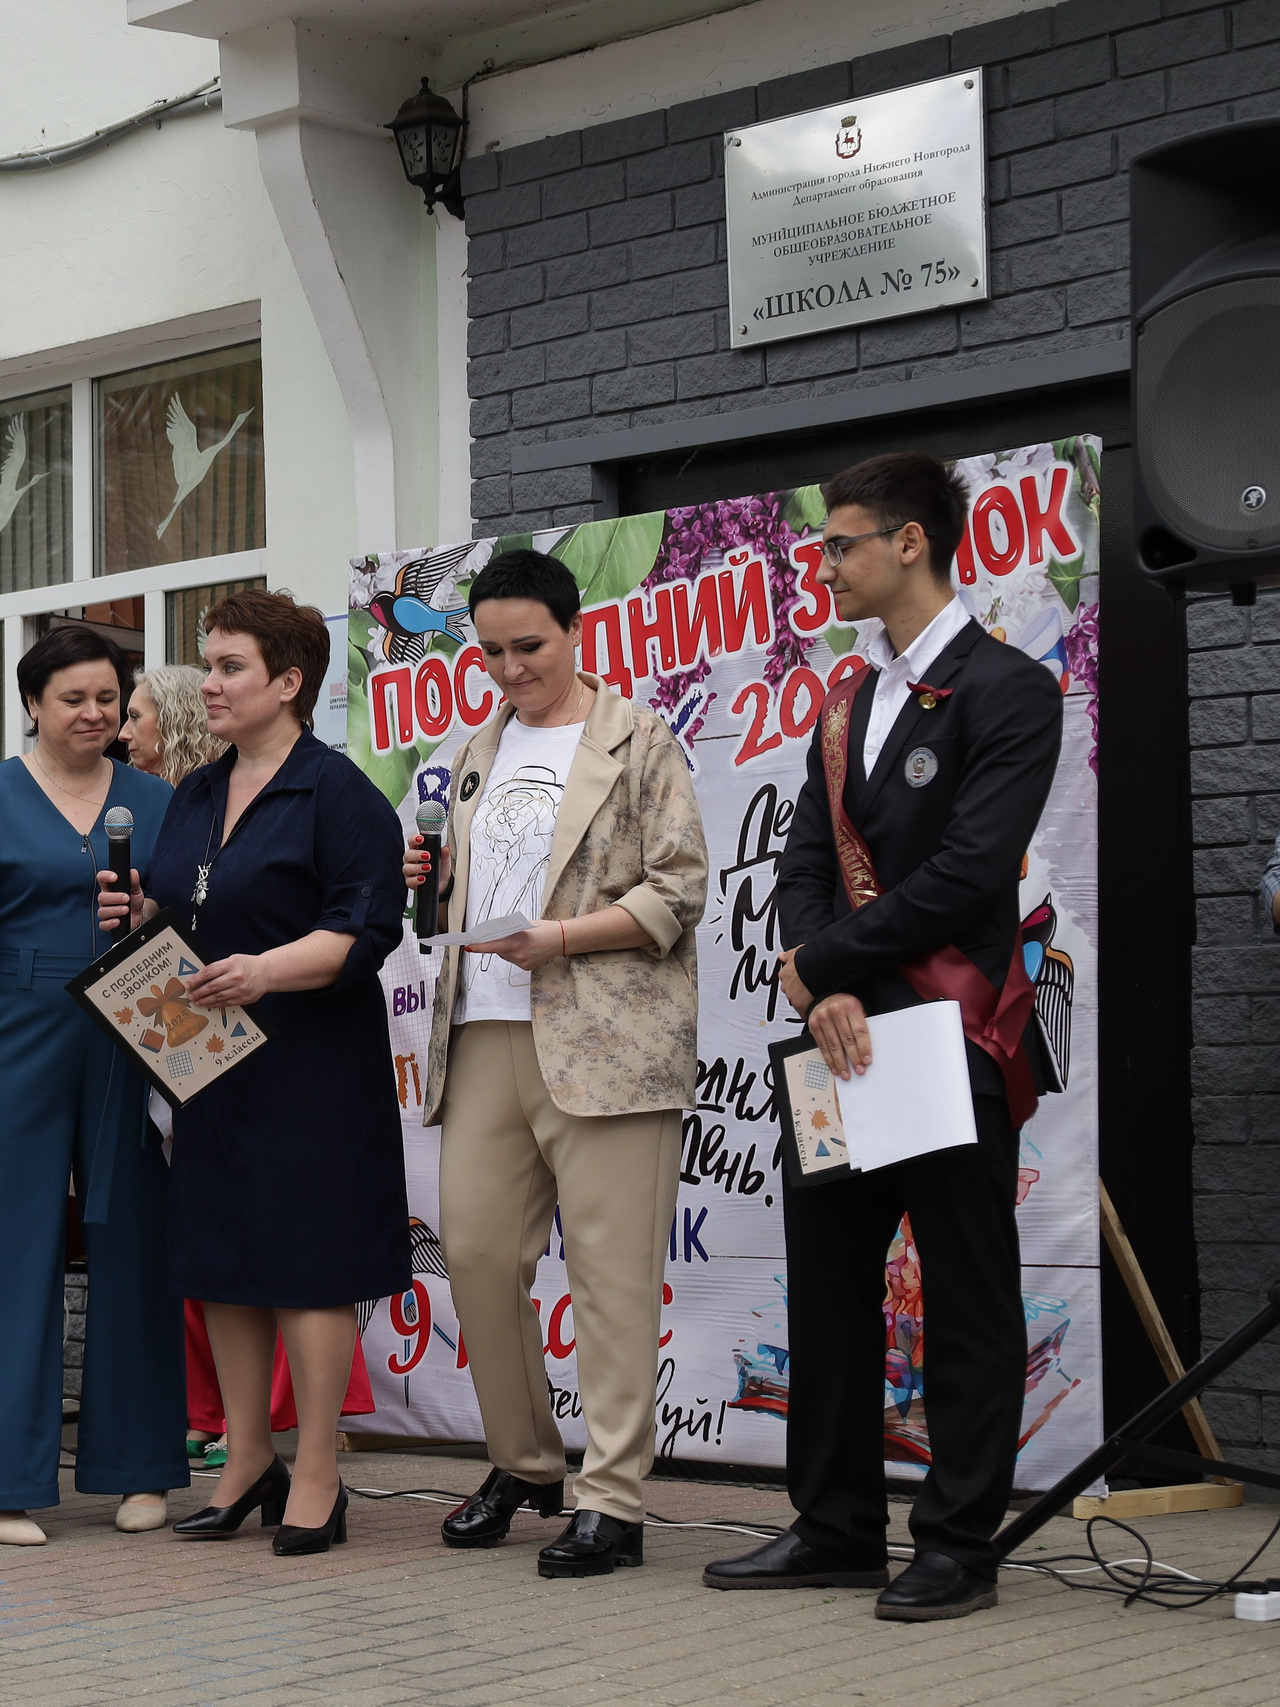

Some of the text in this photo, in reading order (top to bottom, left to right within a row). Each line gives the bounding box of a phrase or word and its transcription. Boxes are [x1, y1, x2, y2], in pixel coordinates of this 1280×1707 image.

[751, 143, 971, 201] Администрация города Нижнего Новгорода
[793, 169, 923, 207] Департамент образования
[751, 191, 957, 247] МУНИЦИПАЛЬНОЕ БЮДЖЕТНОЕ
[773, 213, 933, 258] ОБЩЕОБРАЗОВАТЕЛЬНОЕ
[808, 238, 896, 266] УЧРЕЖДЕНИЕ
[753, 258, 961, 321] «ШКОЛА № 75»
[371, 551, 770, 752] ПОСДНИЙ
[102, 941, 174, 999] С ПОСЛЕДНИМ
[120, 957, 173, 1000] ЗВОНКОМ!
[166, 1009, 190, 1031] 2025
[215, 1032, 262, 1067] 9 классы
[793, 1108, 808, 1167] 9 классы
